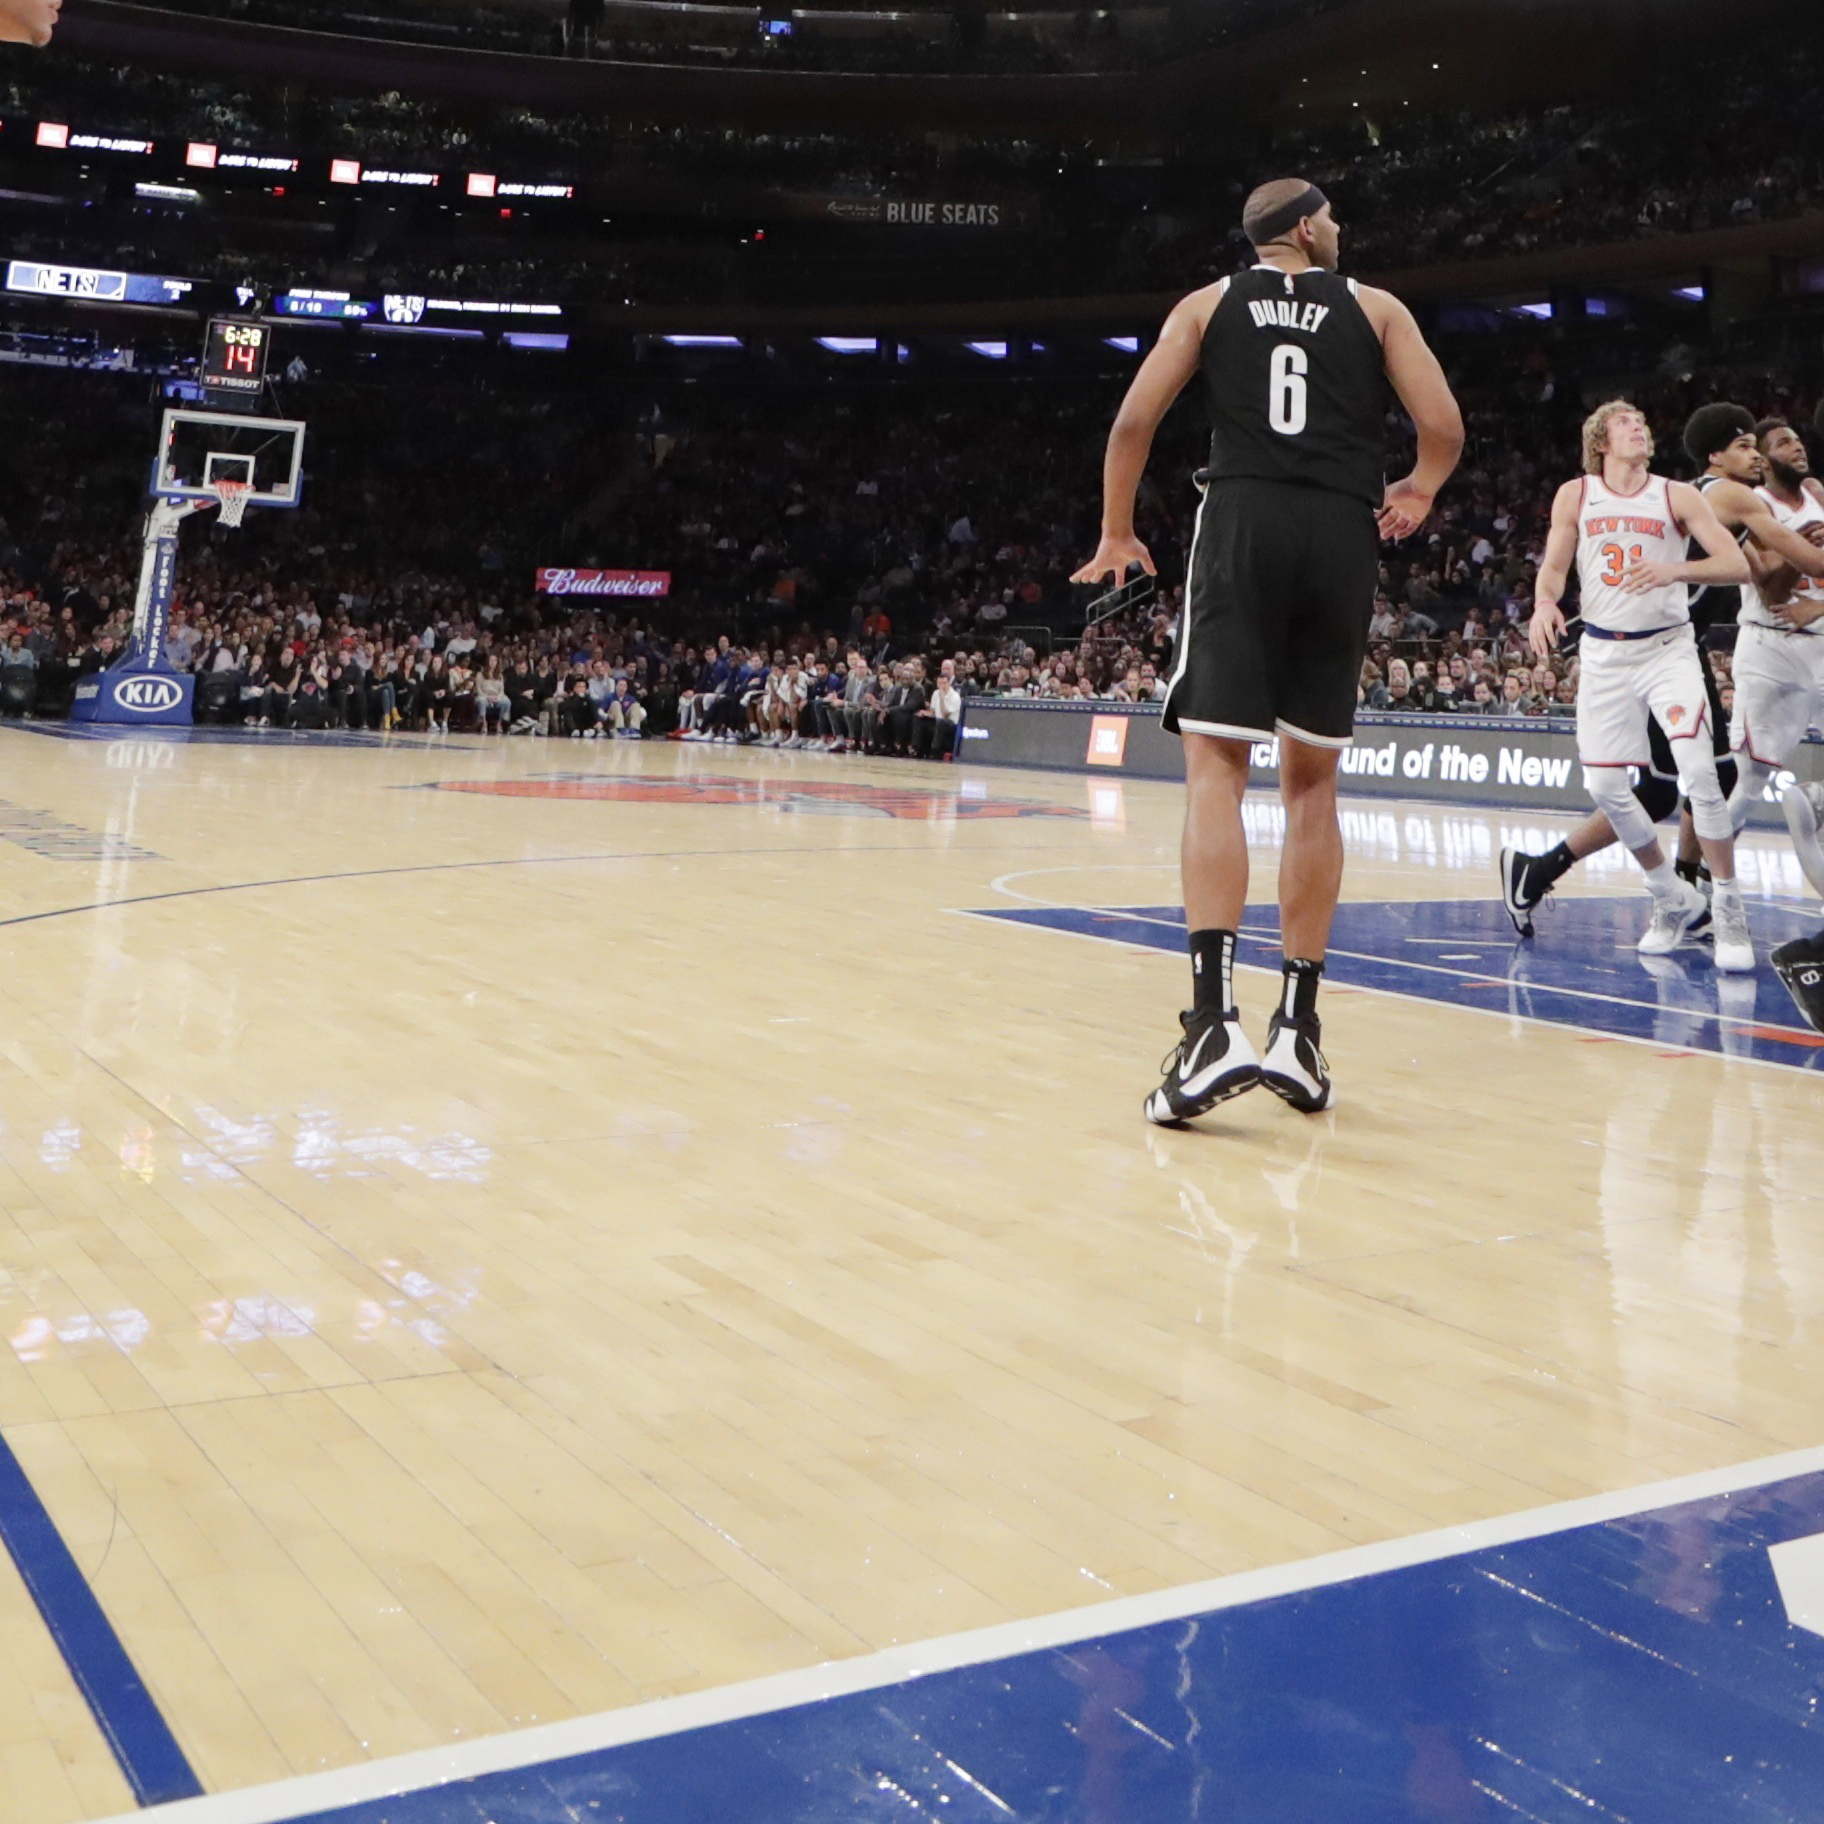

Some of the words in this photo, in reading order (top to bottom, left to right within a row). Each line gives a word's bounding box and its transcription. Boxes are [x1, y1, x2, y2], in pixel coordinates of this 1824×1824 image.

[886, 202, 934, 223] BLUE
[942, 204, 999, 226] SEATS
[37, 268, 99, 293] NETS
[384, 294, 426, 312] NETS
[1246, 299, 1330, 334] DUDLEY
[224, 325, 262, 347] 6:28
[226, 344, 255, 373] 14
[220, 376, 260, 389] TISSOT
[1268, 344, 1308, 436] 6
[1584, 515, 1625, 539] NEW
[1623, 516, 1666, 540] YORK
[544, 569, 663, 596] Budweiser
[126, 683, 171, 705] KIA
[1402, 741, 1436, 777] of
[1439, 747, 1488, 783] the
[1497, 748, 1572, 789] New
